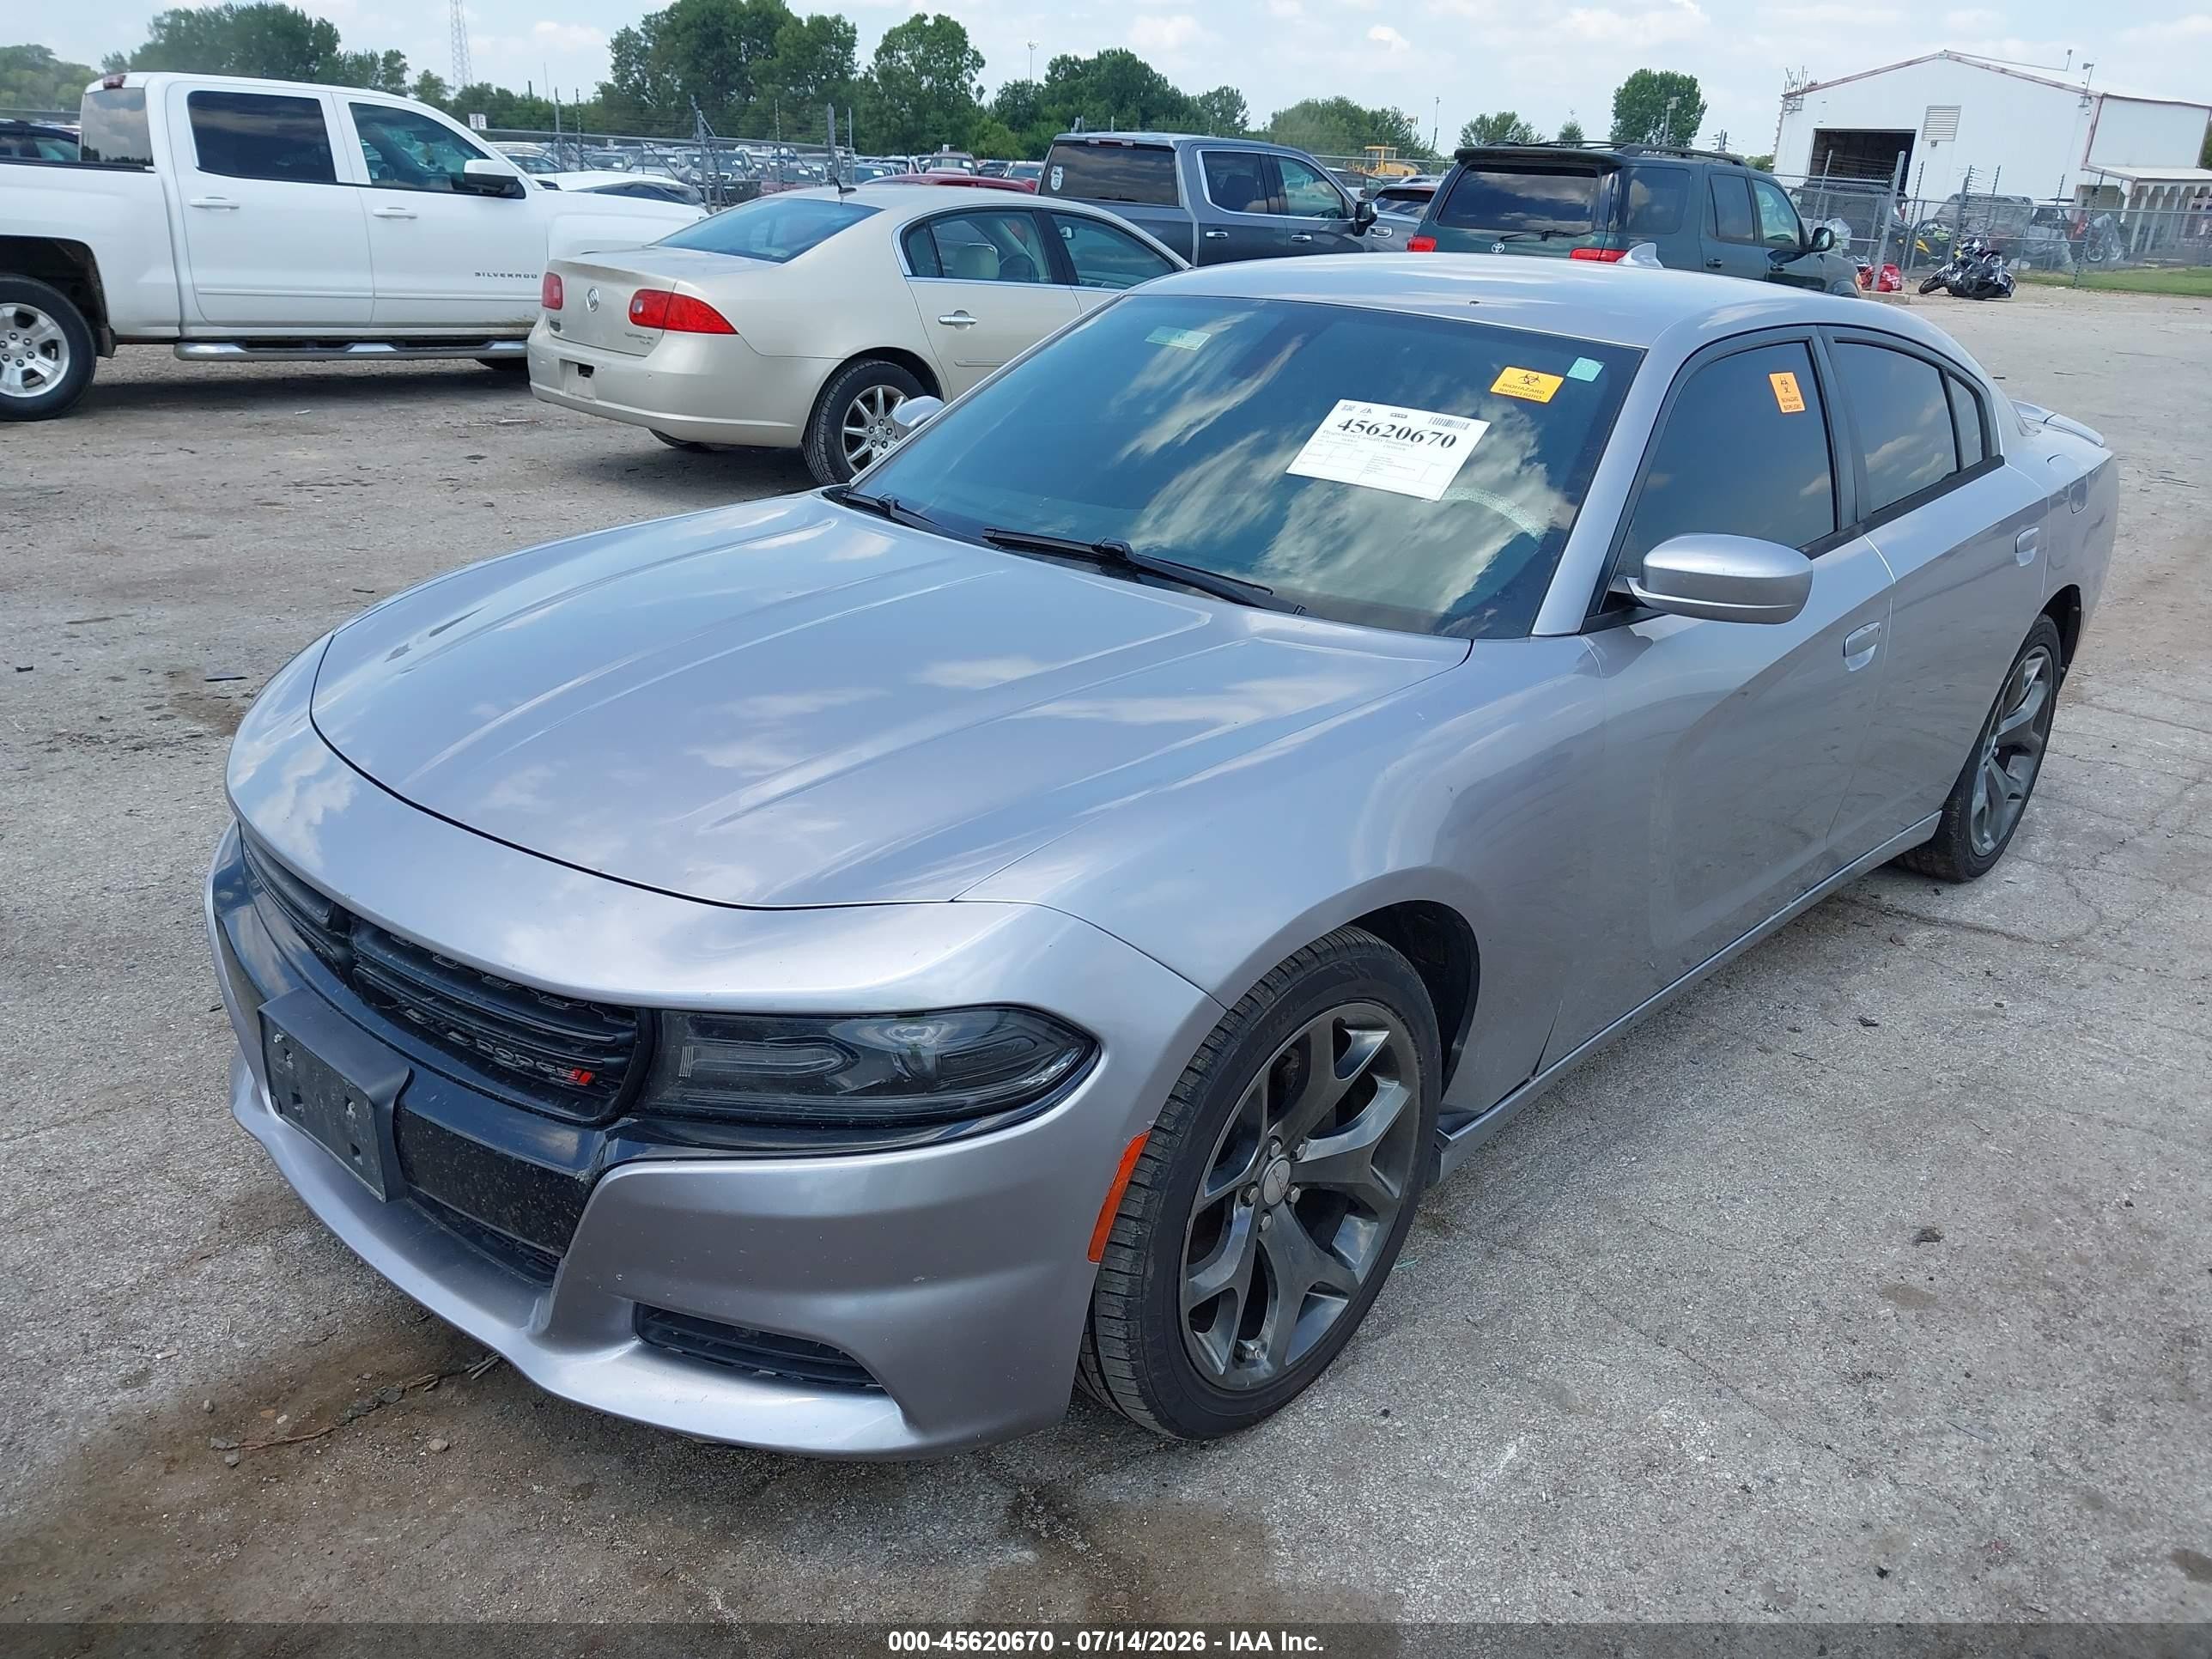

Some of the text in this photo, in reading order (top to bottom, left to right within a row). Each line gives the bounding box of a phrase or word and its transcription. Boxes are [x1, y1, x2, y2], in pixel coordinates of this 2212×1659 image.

[1502, 383, 1545, 395] BIOHAZARD
[1337, 418, 1458, 449] 45620670
[475, 1038, 578, 1080] DODGE
